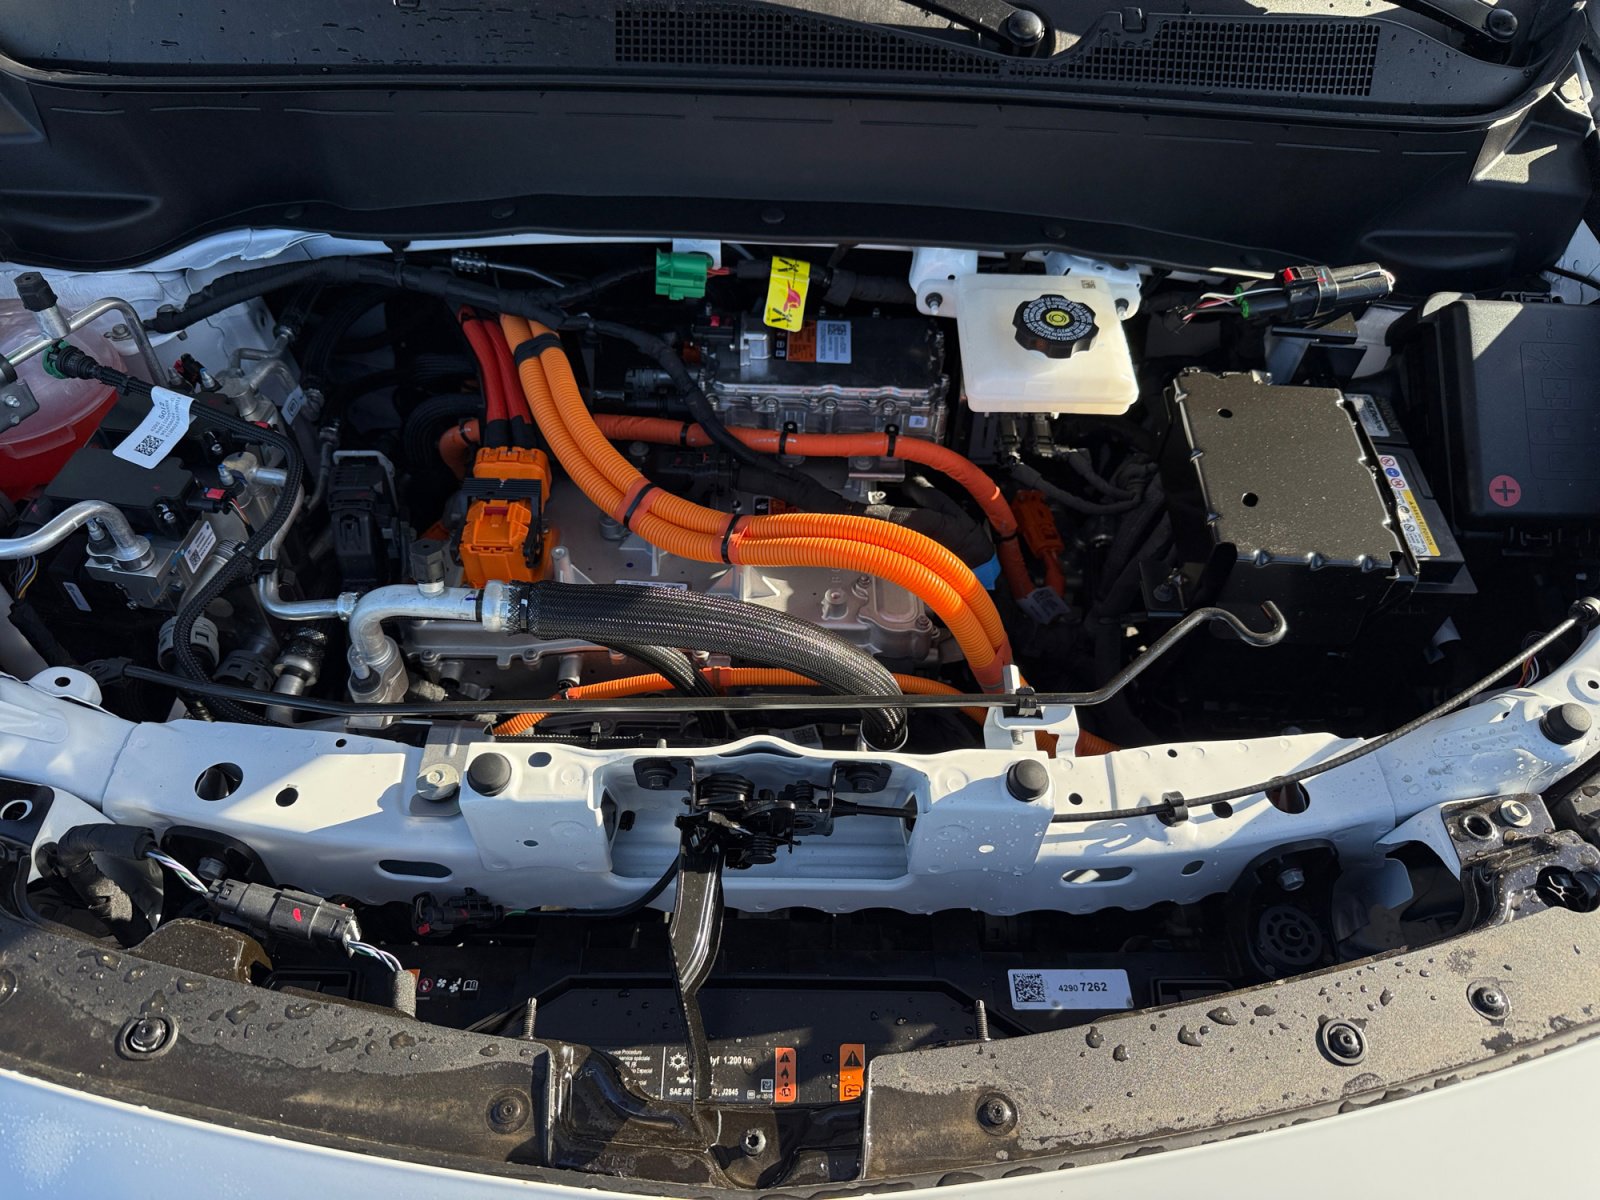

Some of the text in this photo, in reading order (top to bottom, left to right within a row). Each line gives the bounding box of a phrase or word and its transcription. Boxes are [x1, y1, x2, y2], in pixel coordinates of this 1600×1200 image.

[1058, 982, 1108, 992] 4290 7262
[723, 1056, 742, 1065] 1.200
[669, 1087, 682, 1096] SAE
[721, 1088, 739, 1096] J2845
